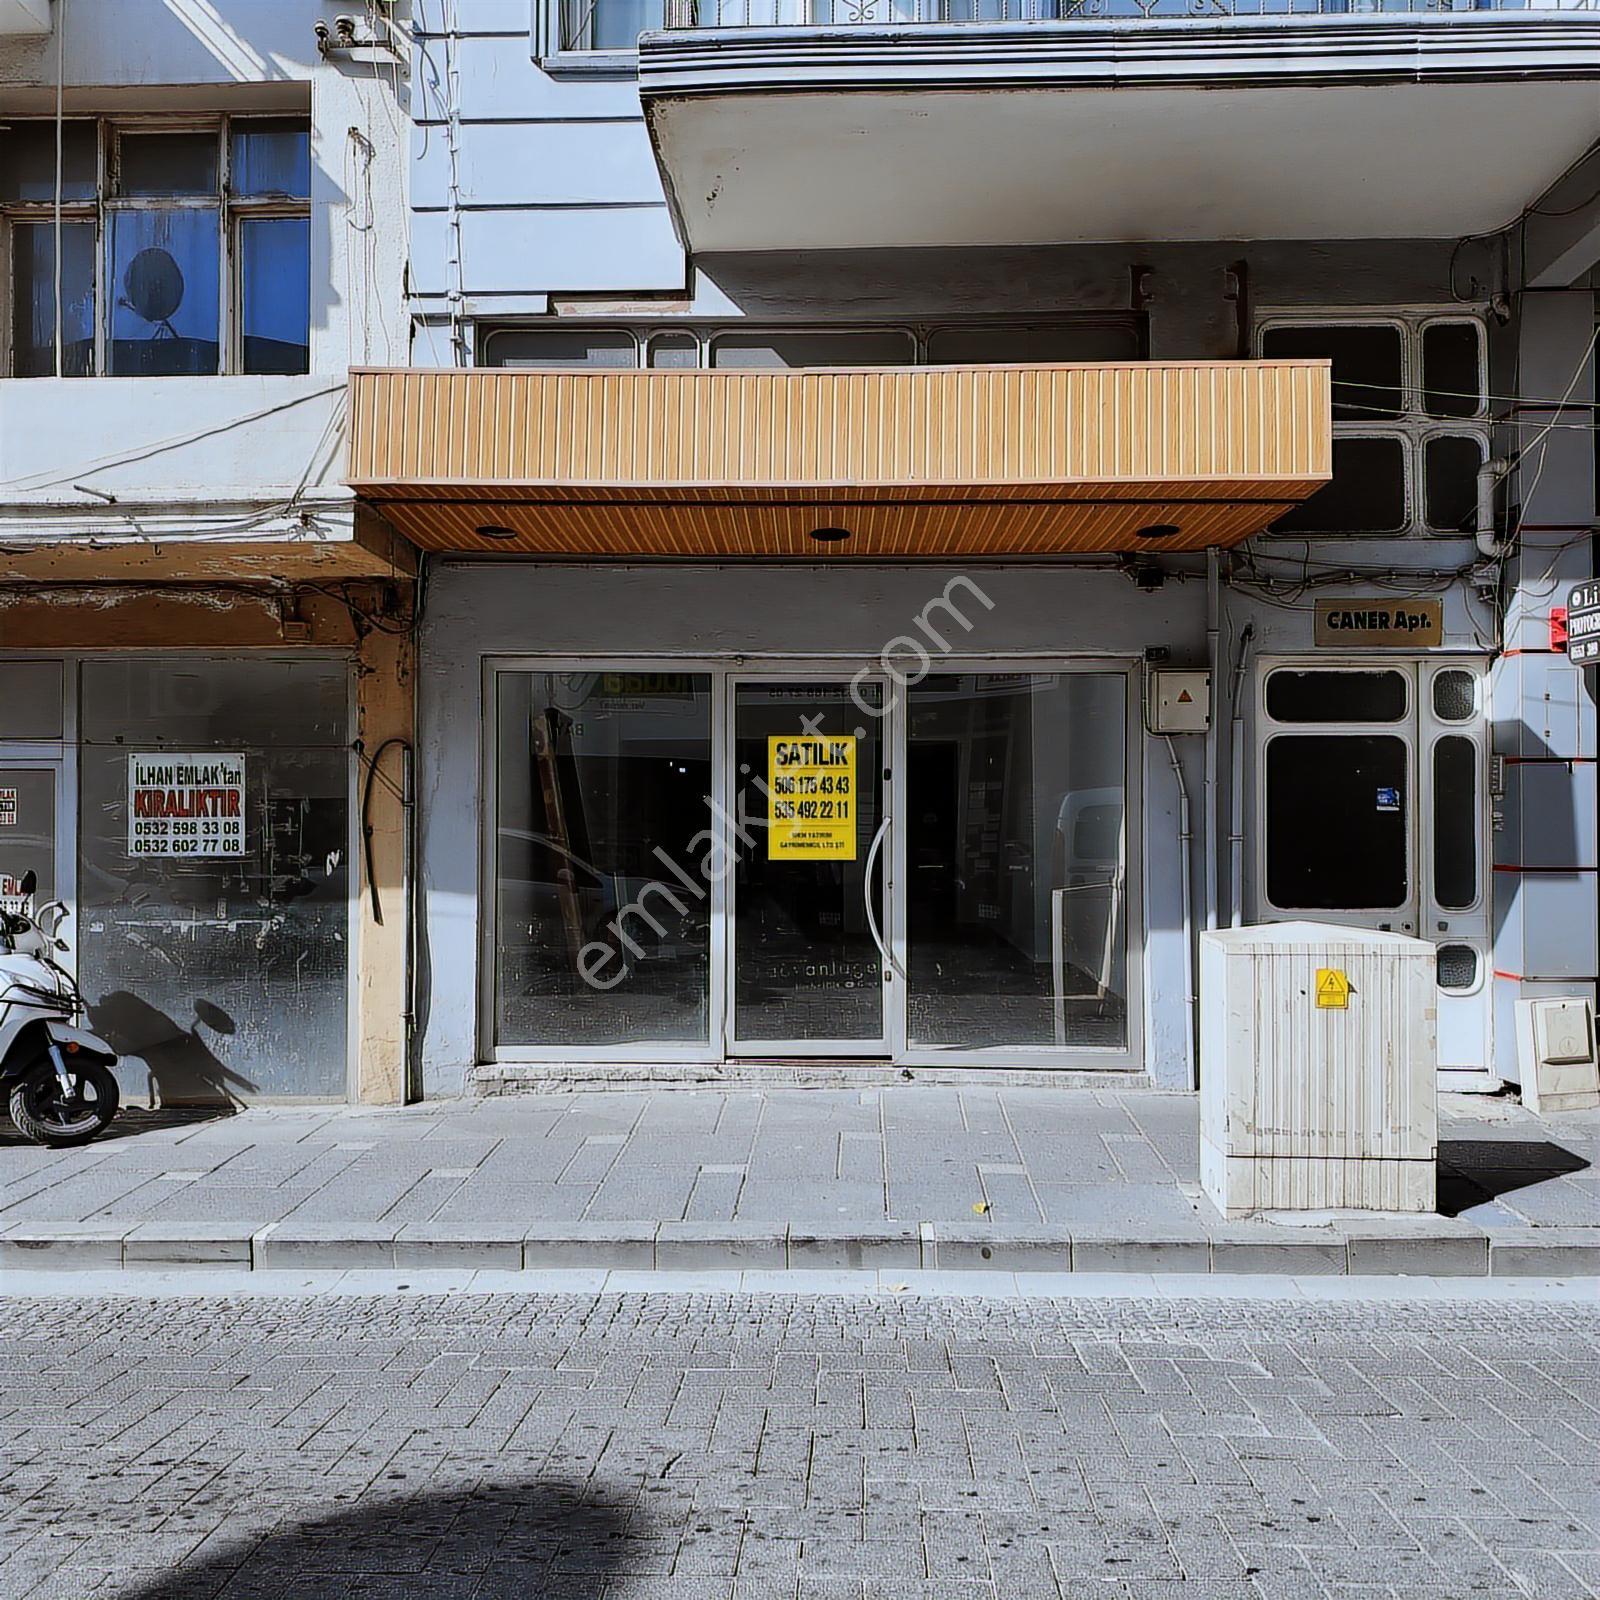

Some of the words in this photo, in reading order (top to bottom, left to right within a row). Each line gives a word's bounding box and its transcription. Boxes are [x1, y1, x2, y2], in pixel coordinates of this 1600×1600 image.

[1327, 611, 1390, 629] CANER
[1394, 610, 1432, 632] Apt.
[776, 742, 848, 765] SATILIK
[135, 762, 173, 785] İLHAN
[176, 761, 242, 785] EMLAK'tan
[820, 776, 833, 794] 43
[836, 776, 849, 794] 43
[134, 789, 241, 818] KIRALIKTIR
[797, 800, 818, 819] 492
[820, 800, 833, 819] 22
[837, 800, 849, 819] 11
[135, 822, 169, 835] 0532
[172, 822, 198, 835] 598
[202, 822, 219, 835] 33
[223, 822, 240, 835] 08
[134, 839, 169, 852] 0532
[172, 839, 198, 852] 602
[202, 839, 218, 852] 77
[223, 839, 240, 852] 08
